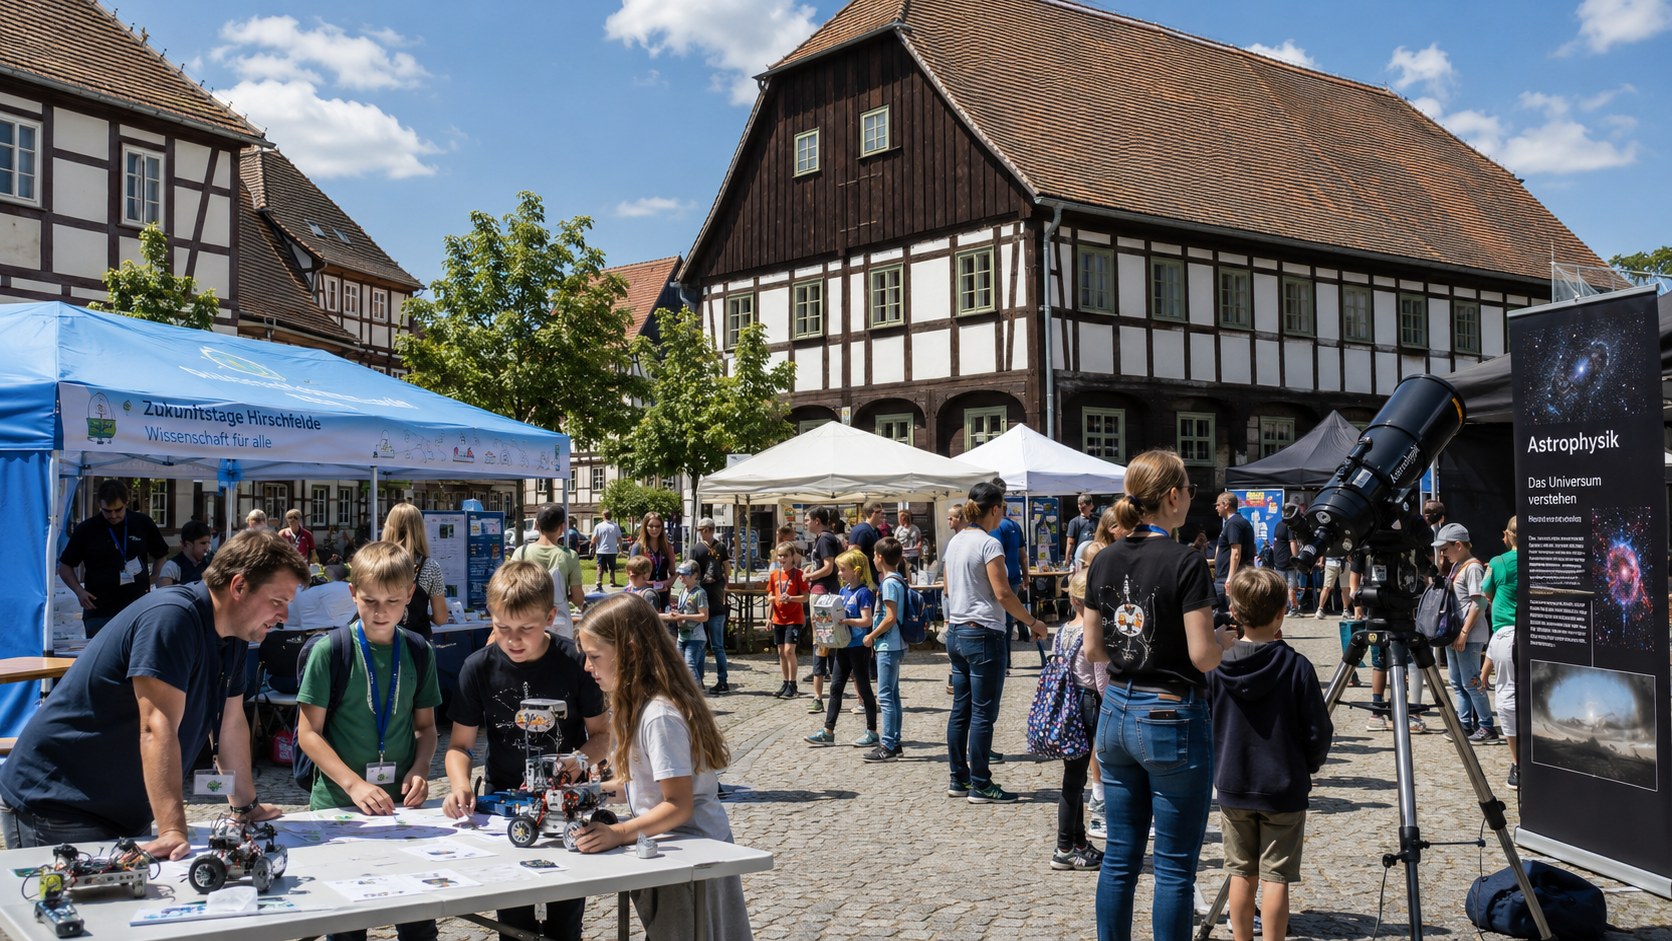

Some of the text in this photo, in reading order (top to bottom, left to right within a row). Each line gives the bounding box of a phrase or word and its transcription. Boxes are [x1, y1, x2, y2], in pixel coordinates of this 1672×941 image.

[247, 409, 322, 430] Hirschfelde
[144, 425, 272, 449] Wissenschaft für alle
[1527, 429, 1620, 455] Astrophysik
[1528, 475, 1602, 489] Das Universum
[1528, 492, 1577, 505] verstehen
